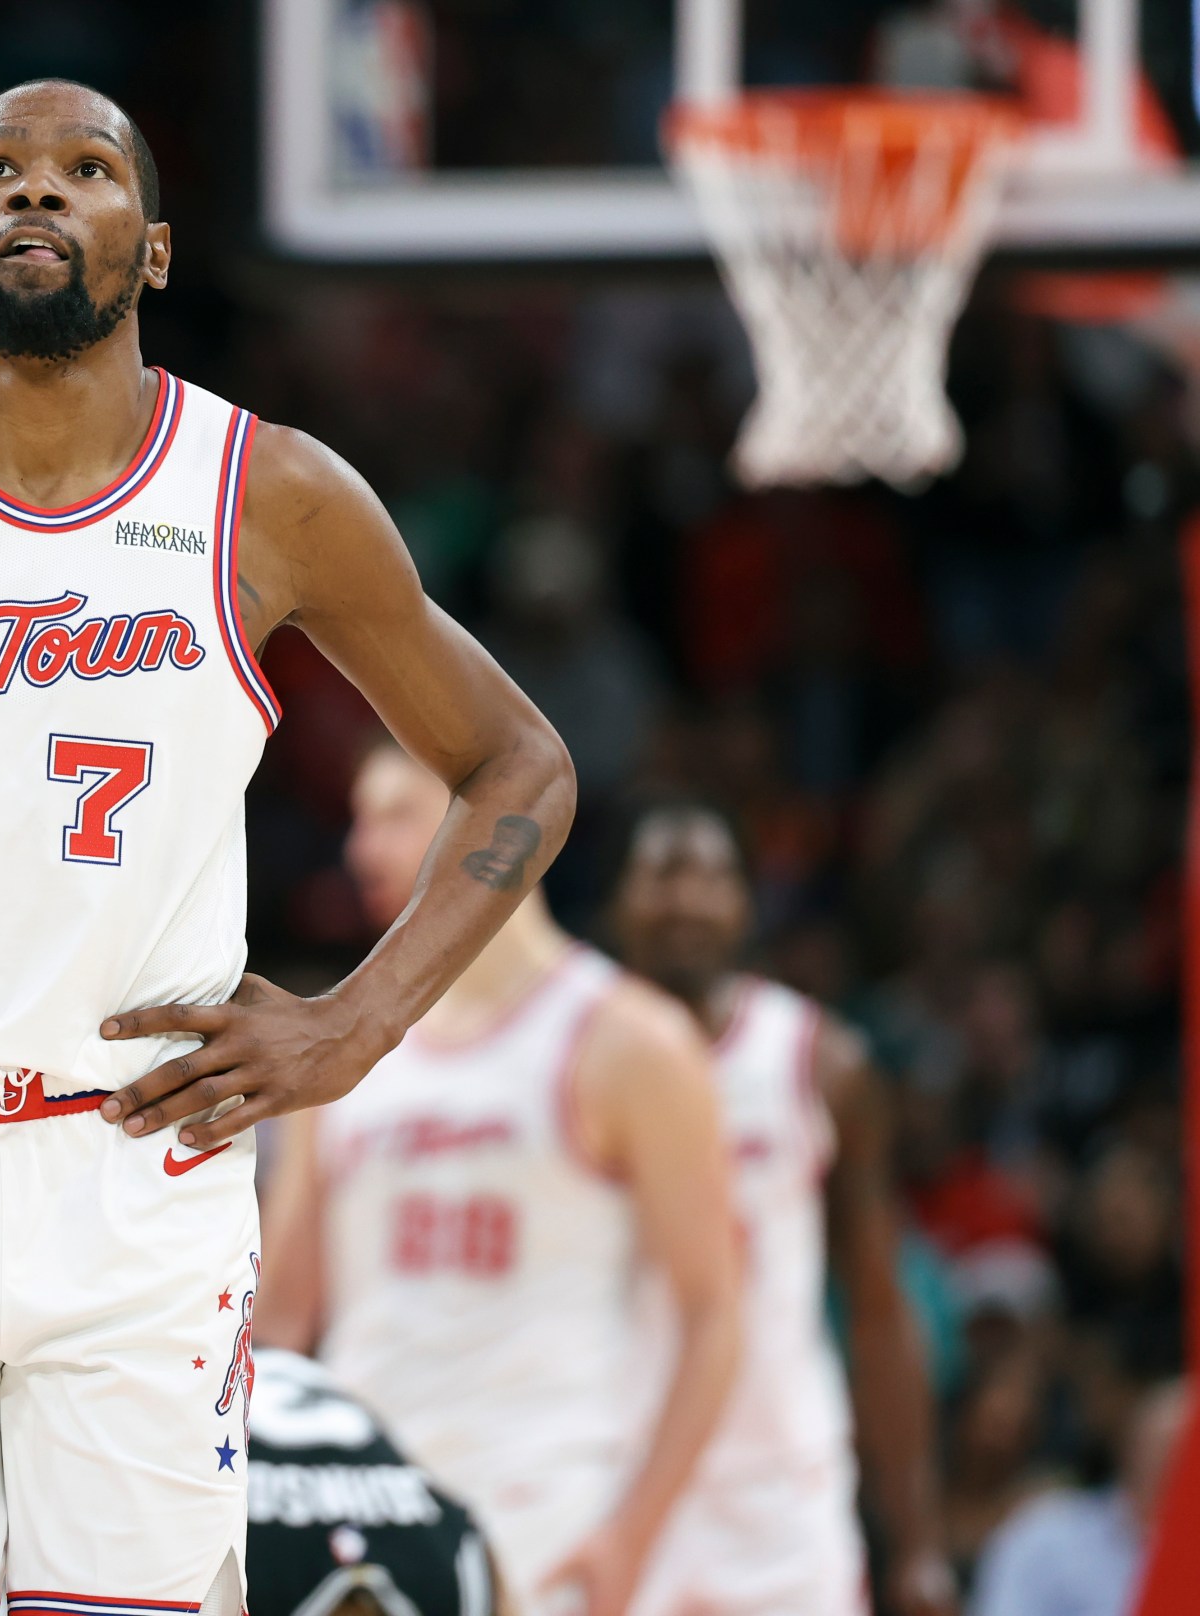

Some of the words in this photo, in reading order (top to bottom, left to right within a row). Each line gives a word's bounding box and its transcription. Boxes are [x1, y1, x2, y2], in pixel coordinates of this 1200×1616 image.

[115, 519, 207, 544] MEMORIAL
[115, 530, 206, 555] HERMANN
[46, 732, 154, 867] 7
